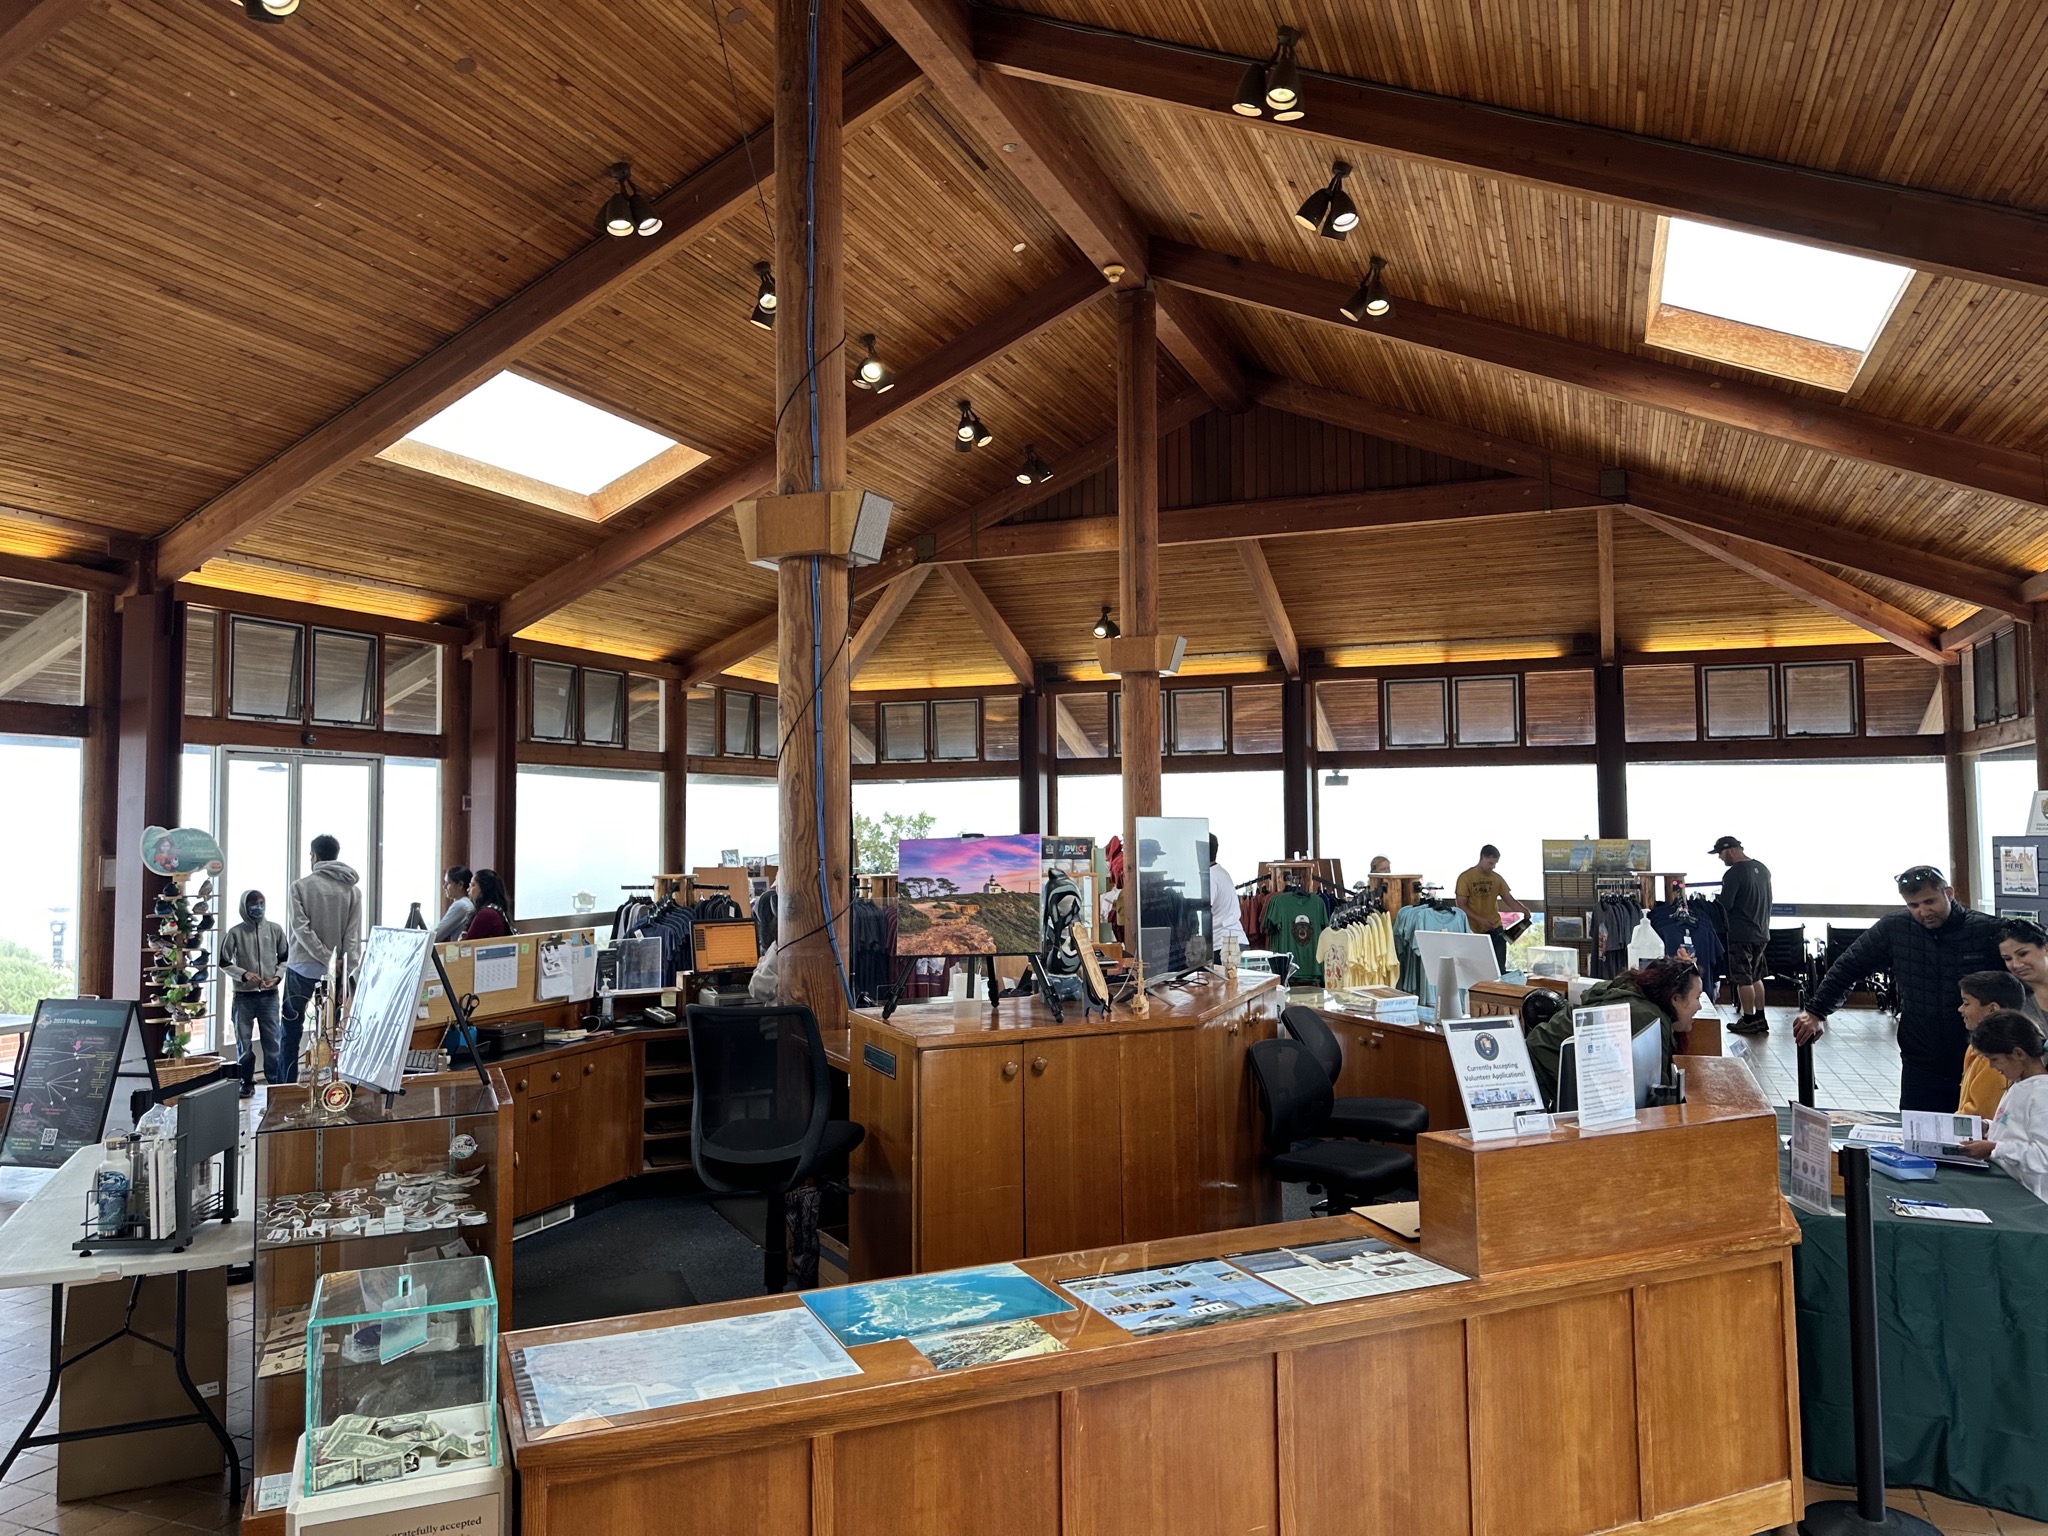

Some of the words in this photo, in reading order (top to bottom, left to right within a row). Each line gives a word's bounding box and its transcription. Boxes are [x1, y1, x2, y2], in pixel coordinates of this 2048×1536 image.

[1059, 844, 1088, 853] ADVICE
[1466, 1064, 1492, 1072] Currently
[1493, 1062, 1519, 1070] Accepting
[1464, 1074, 1491, 1082] Volunteer
[1492, 1070, 1526, 1080] Applications!
[439, 1516, 482, 1531] accepted
